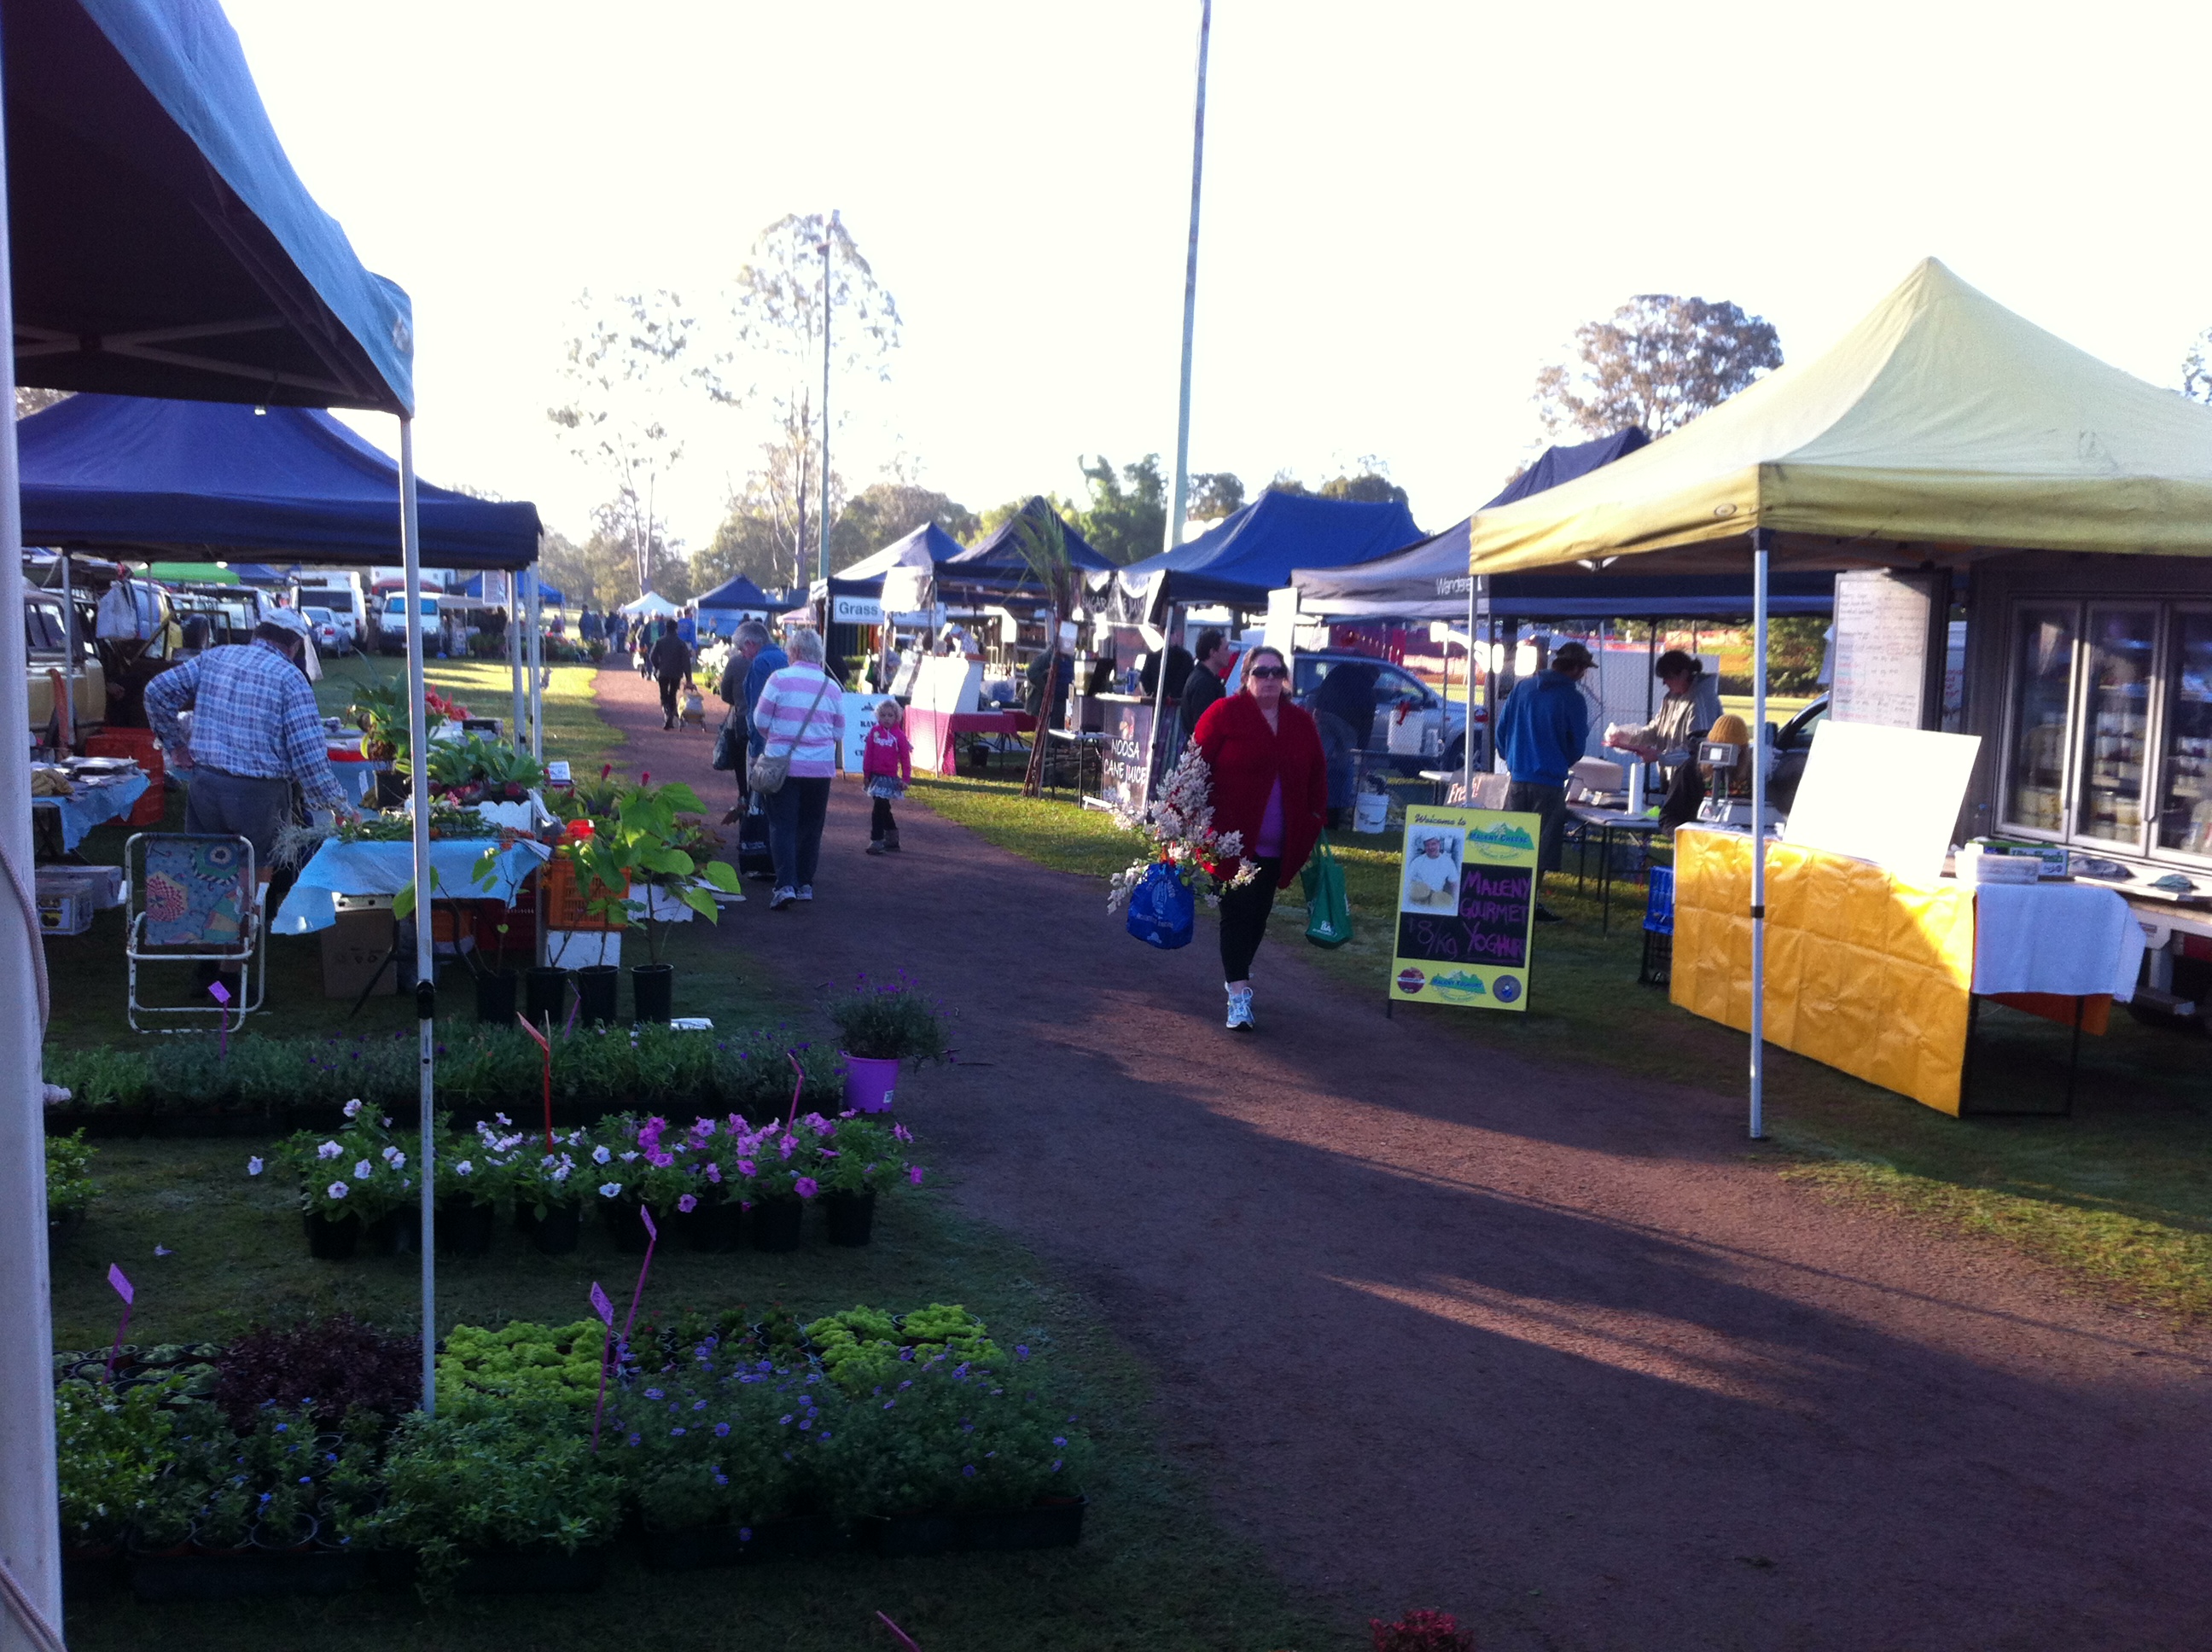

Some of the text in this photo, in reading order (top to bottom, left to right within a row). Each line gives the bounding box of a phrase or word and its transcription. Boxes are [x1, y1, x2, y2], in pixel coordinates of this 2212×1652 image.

[1436, 576, 1473, 595] Wandere
[839, 602, 879, 616] Grass
[1108, 596, 1126, 613] CAE
[1111, 739, 1139, 760] NOOSA
[1104, 759, 1147, 784] CANE JUICE
[1414, 813, 1466, 826] Welcome to
[1462, 870, 1532, 900] MALENY
[1459, 898, 1529, 925] GOURMET
